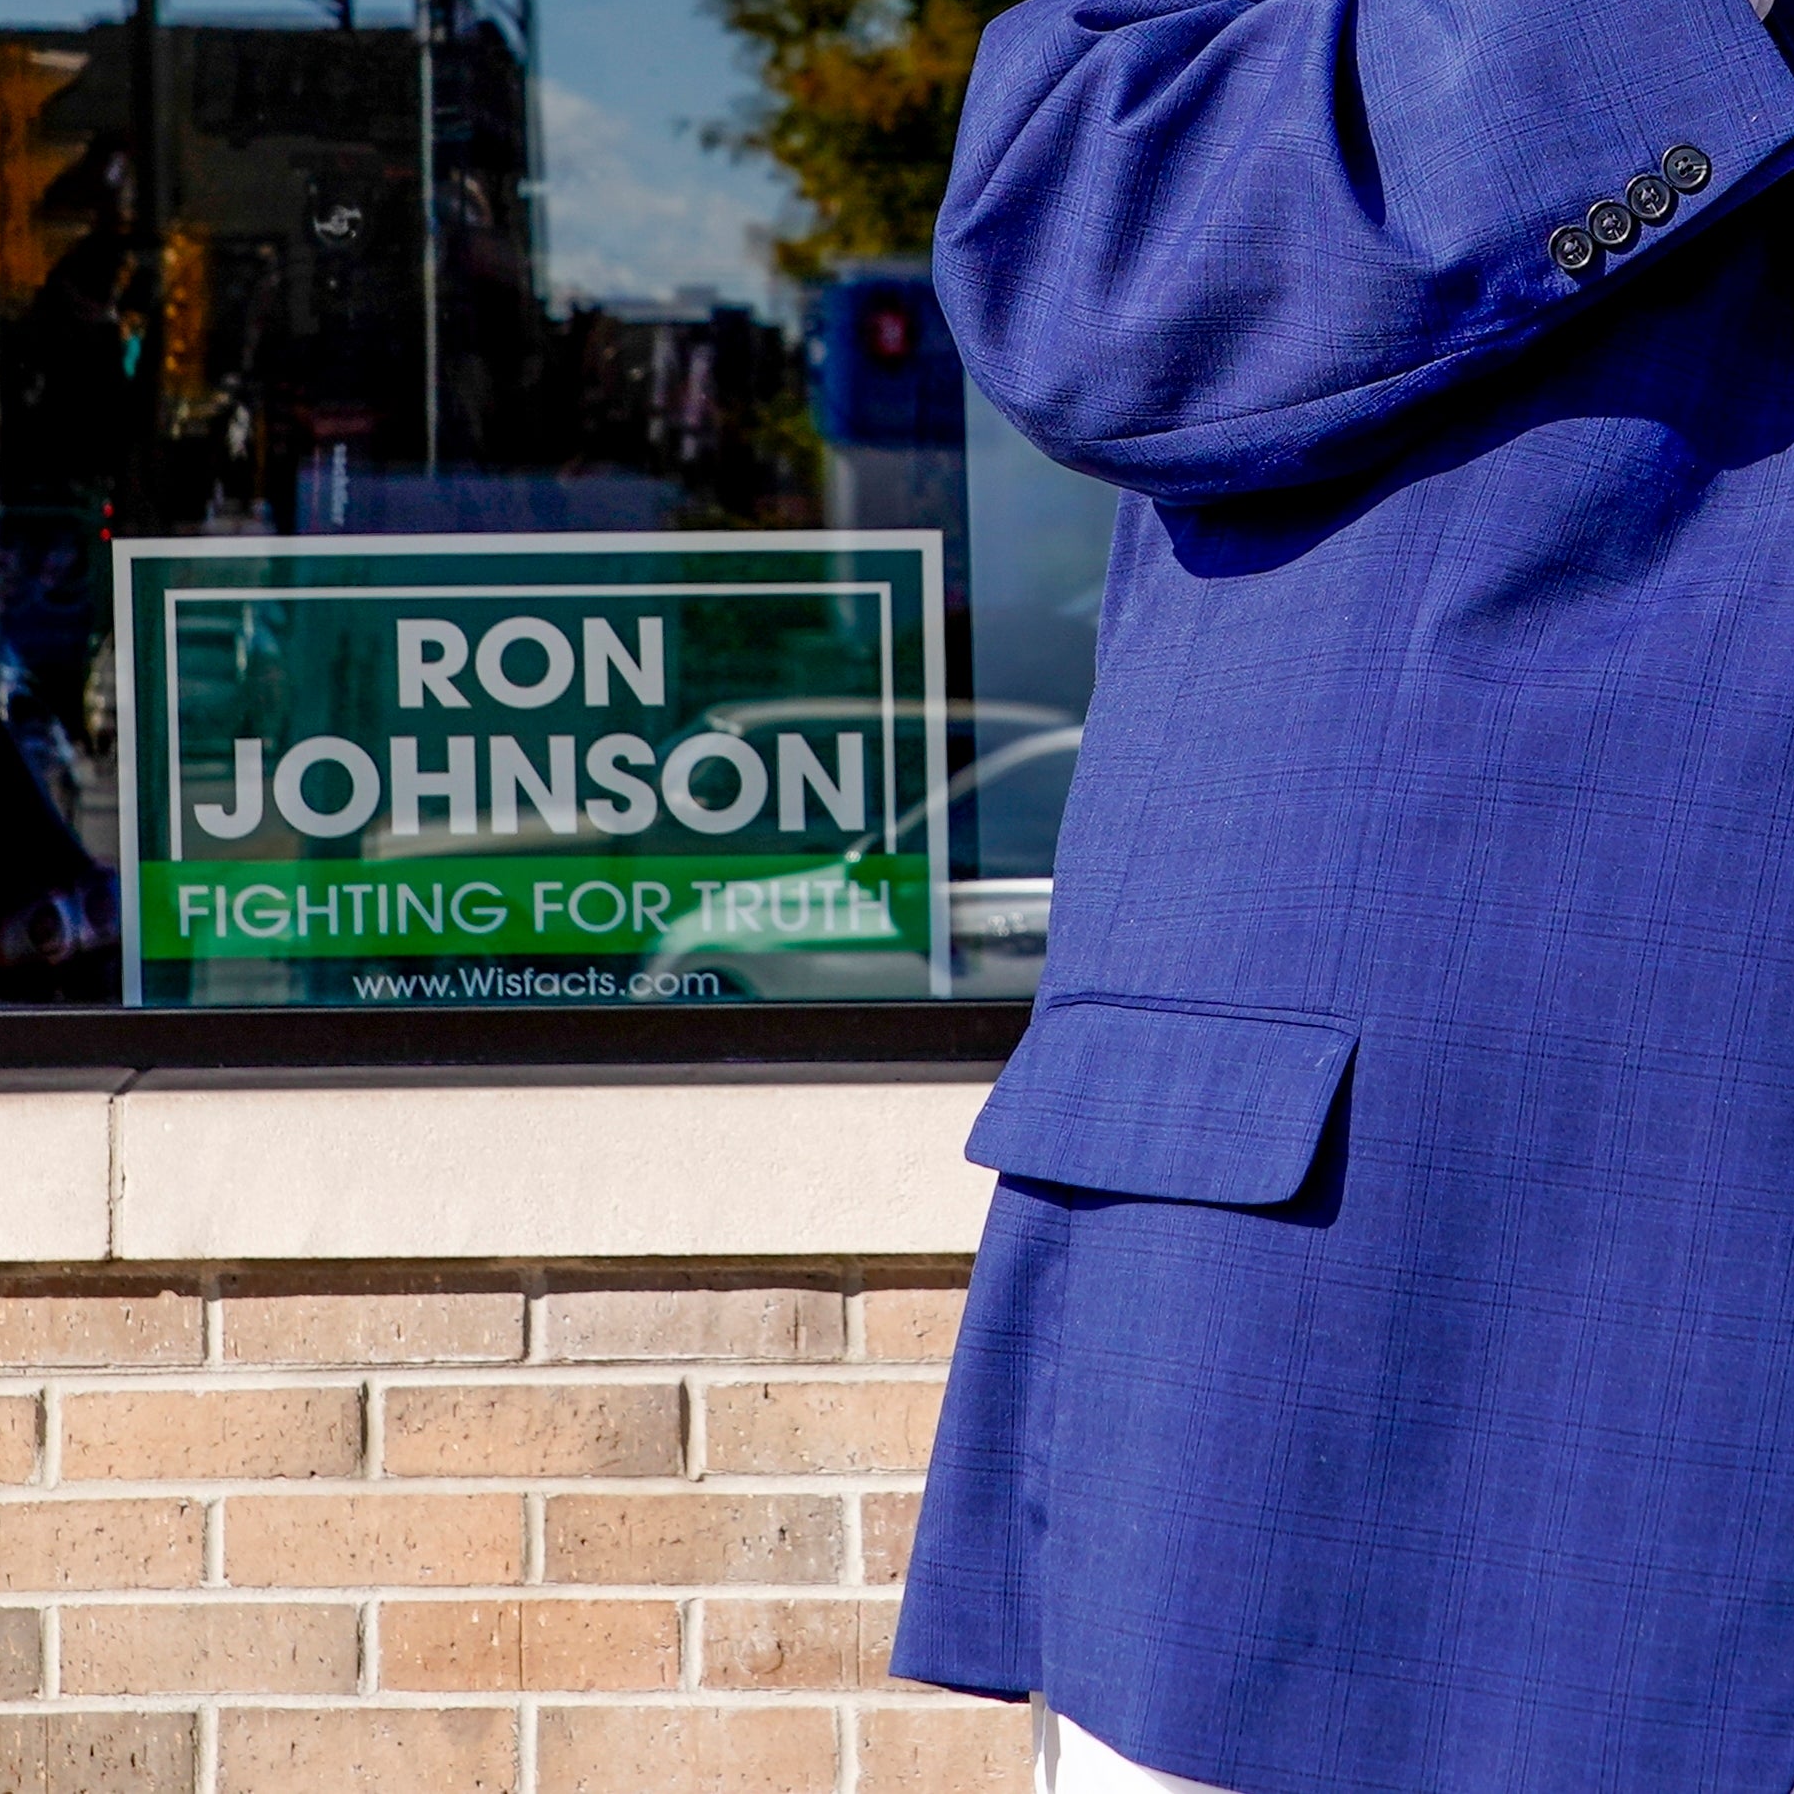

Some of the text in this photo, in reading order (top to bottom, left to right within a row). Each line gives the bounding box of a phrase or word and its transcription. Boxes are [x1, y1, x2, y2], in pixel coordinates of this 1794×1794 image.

[396, 615, 667, 710] RON
[192, 731, 866, 841] JOHNSON
[176, 878, 894, 939] FIGHTING FOR TRUTH
[352, 965, 721, 1002] www.Wisfacts.com
